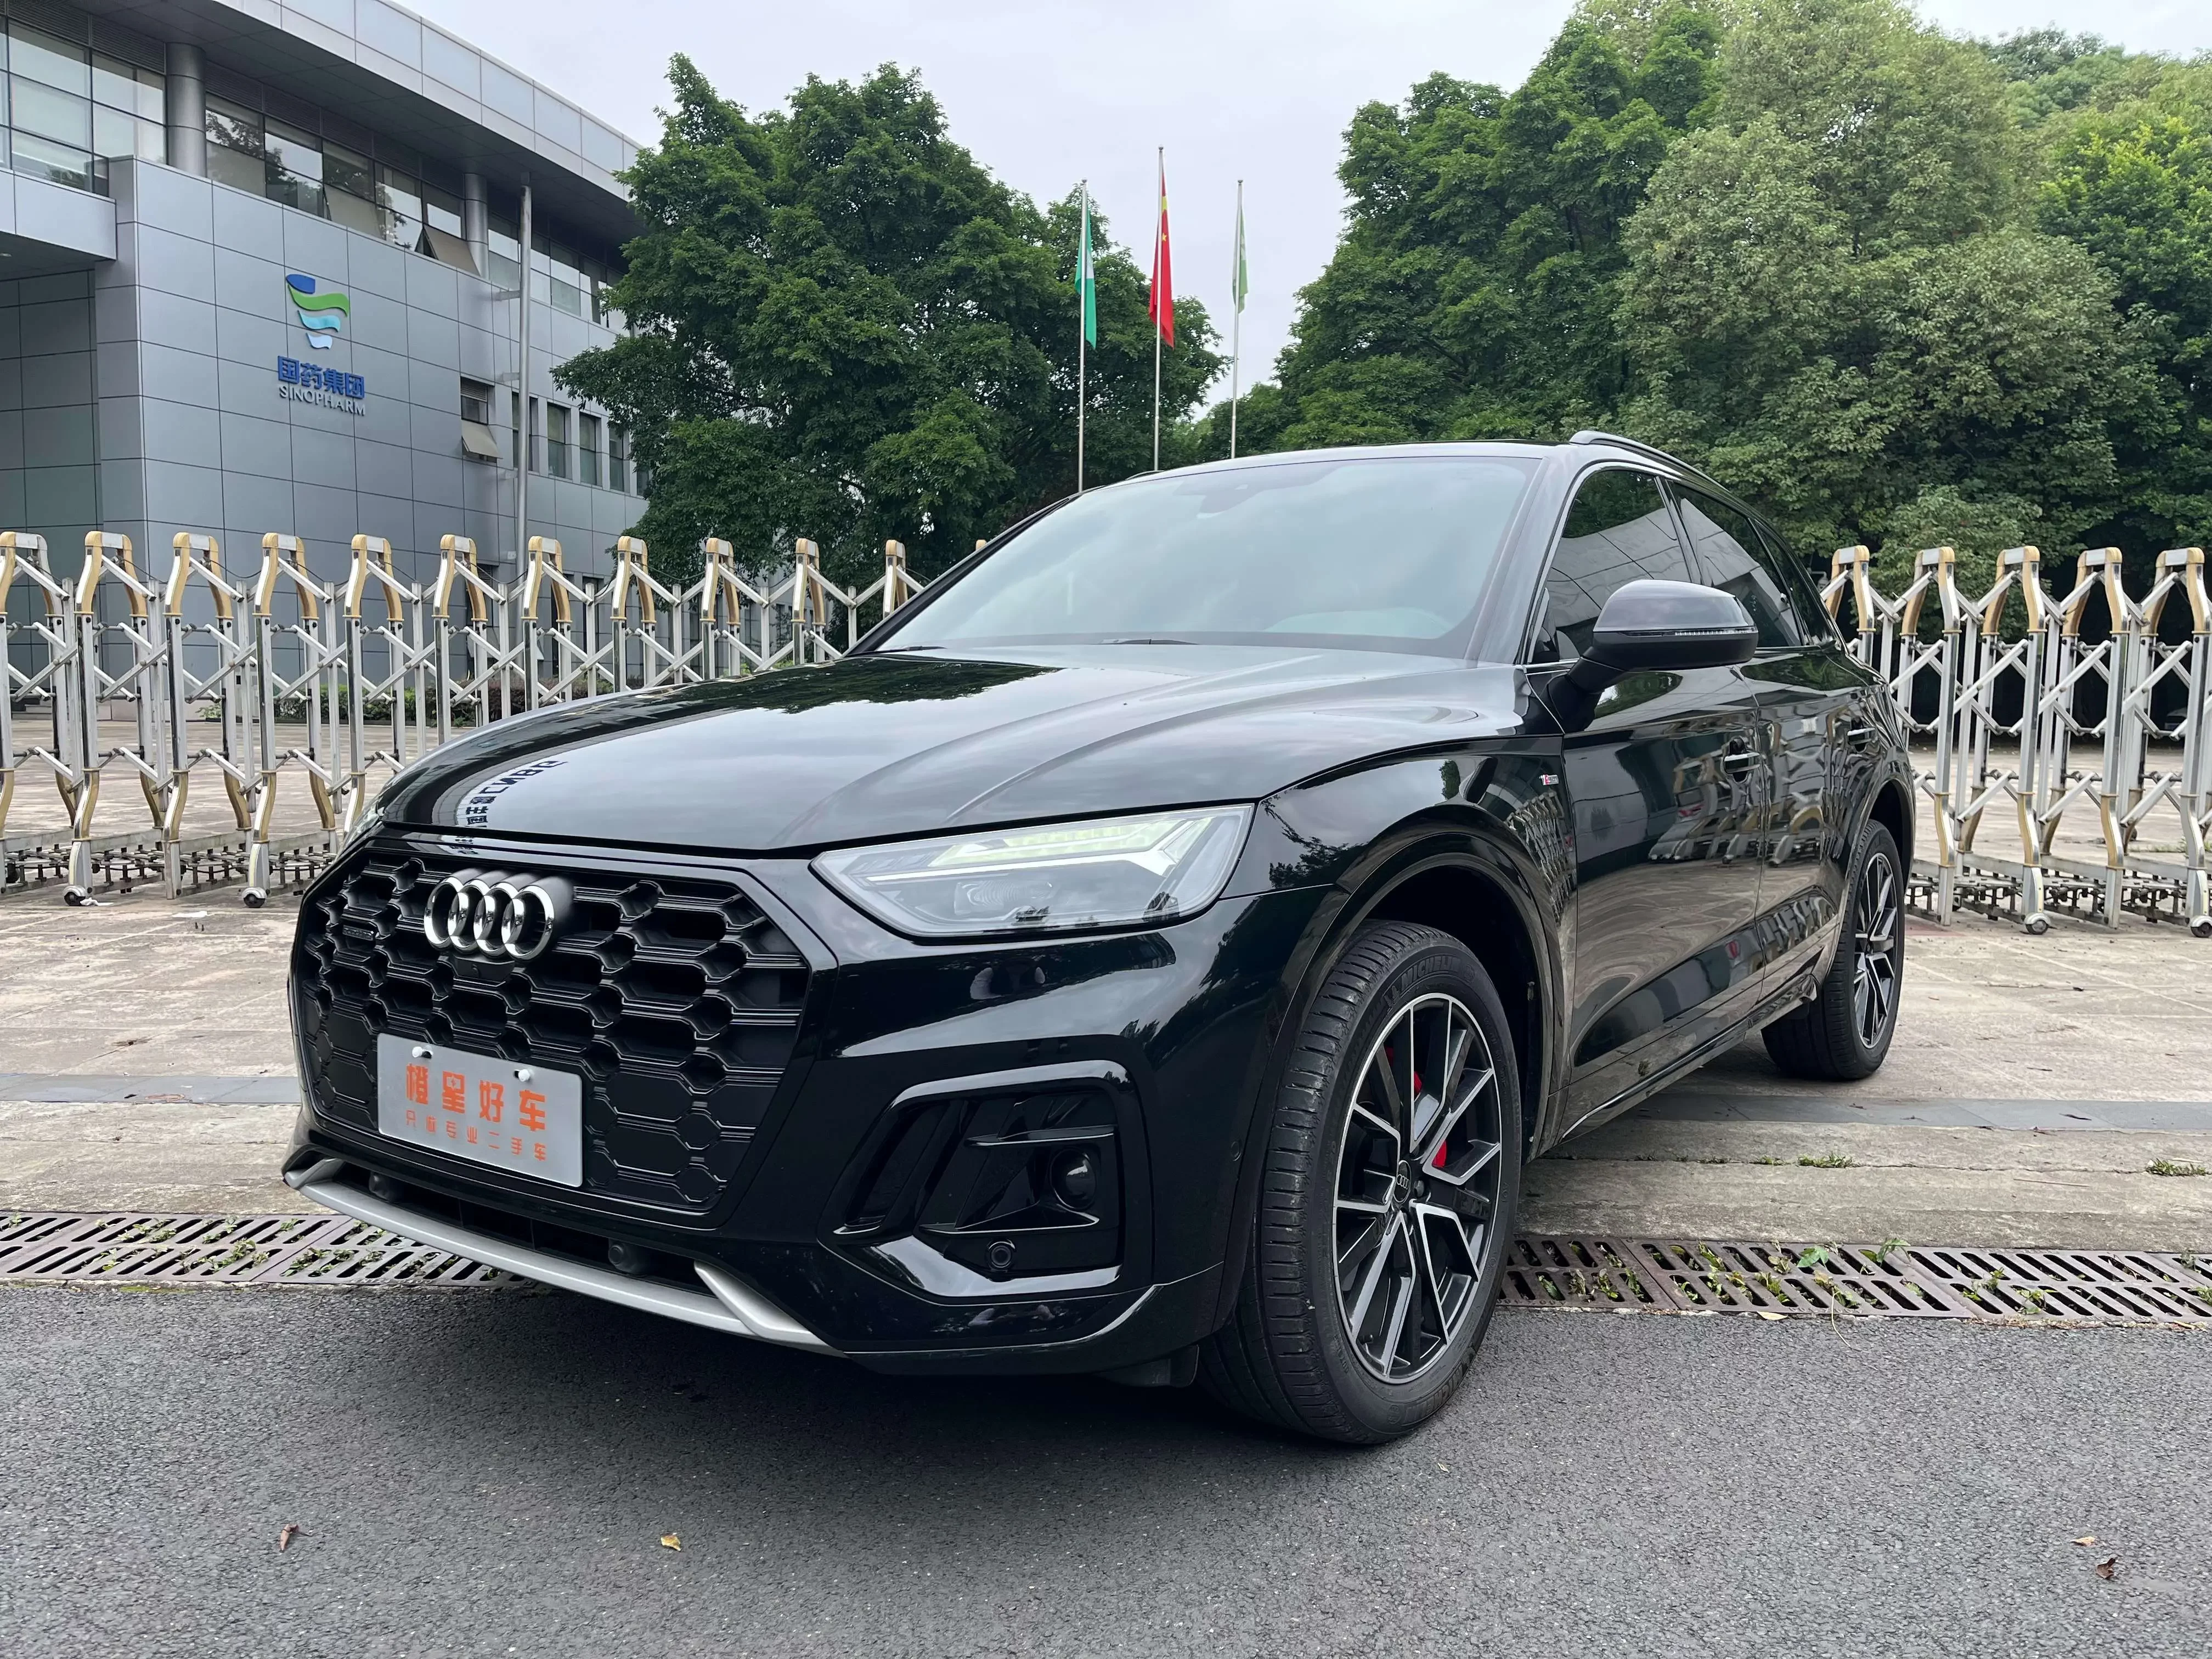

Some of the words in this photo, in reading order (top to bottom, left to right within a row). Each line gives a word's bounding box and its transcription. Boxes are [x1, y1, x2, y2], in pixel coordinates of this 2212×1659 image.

[278, 356, 365, 399] 国药集团
[279, 385, 366, 416] SINOPHARM
